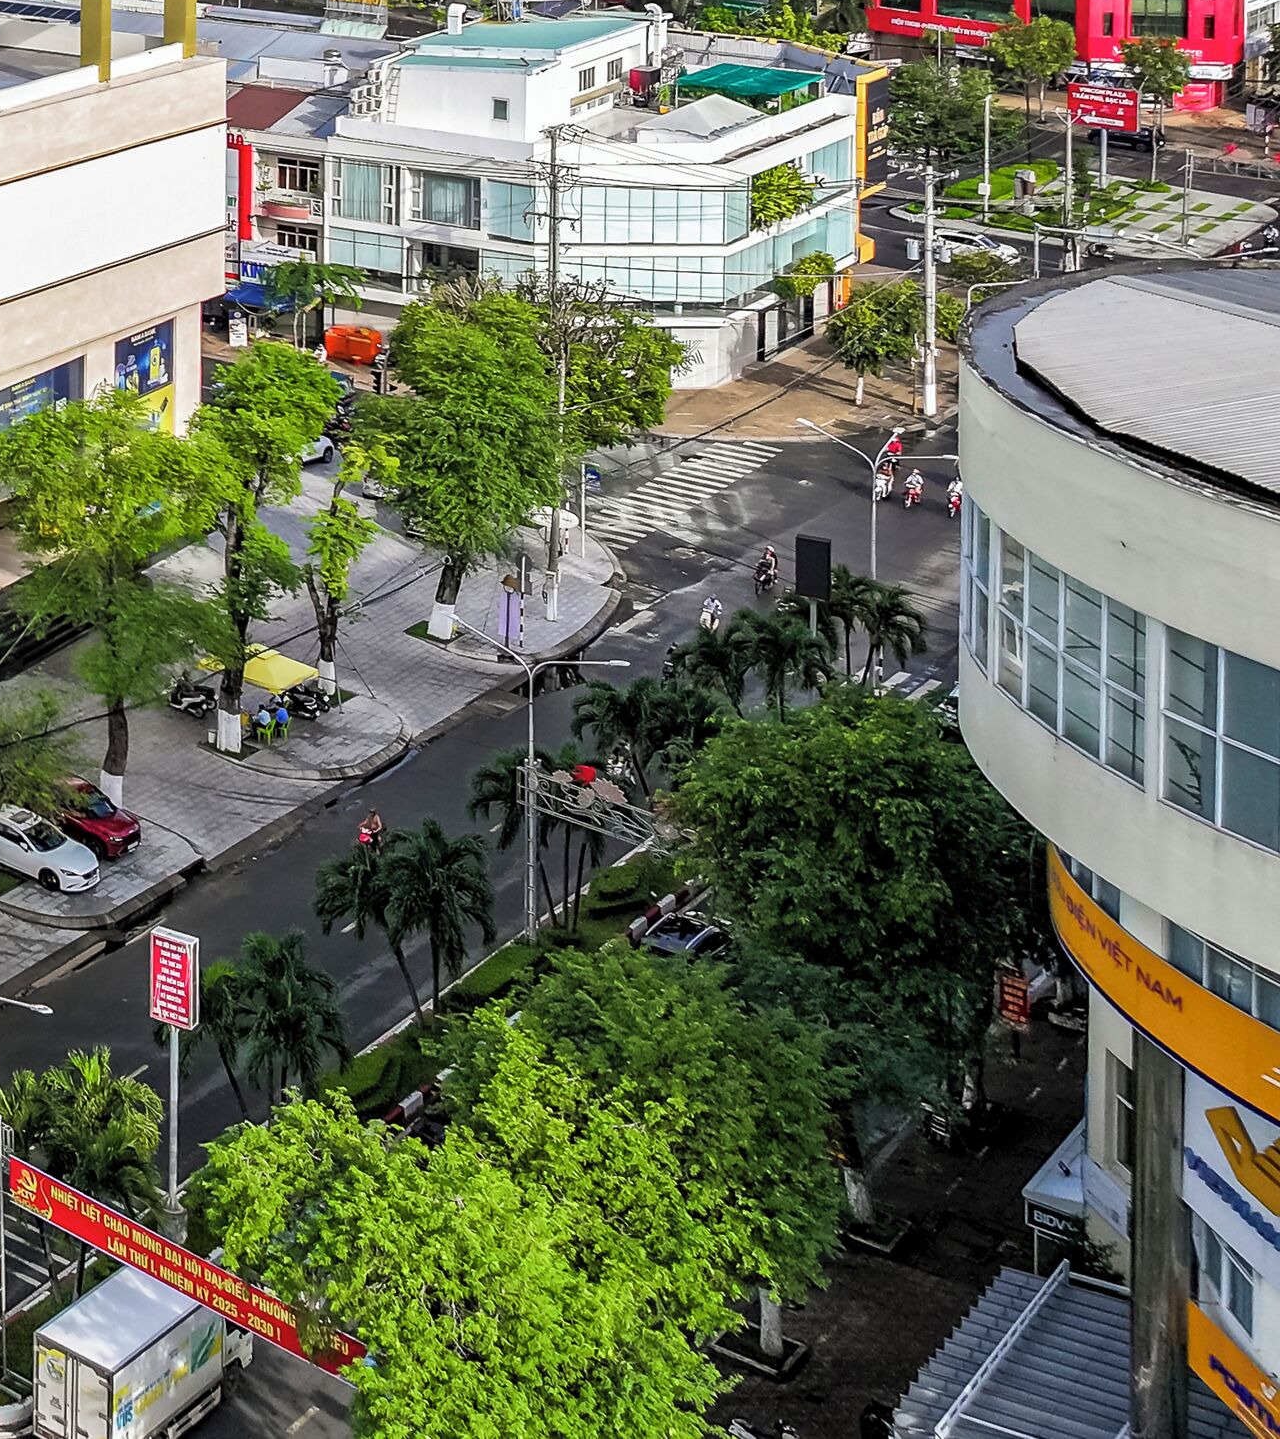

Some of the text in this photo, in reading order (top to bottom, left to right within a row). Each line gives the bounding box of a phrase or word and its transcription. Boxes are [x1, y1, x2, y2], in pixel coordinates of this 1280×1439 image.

[1106, 90, 1127, 98] PLAZA
[1098, 930, 1133, 973] VIỆT
[1136, 965, 1183, 1013] NAM
[50, 1185, 79, 1211] NHIỆT
[81, 1199, 101, 1224] LIỆT
[103, 1212, 130, 1239] CHÀO
[132, 1228, 162, 1257] MỪNG
[164, 1246, 182, 1267] ĐẠI
[184, 1259, 202, 1279] HỘI
[107, 1236, 127, 1259] LẦN
[129, 1247, 149, 1268] THỨ
[159, 1264, 194, 1294] NHIỆM
[212, 1294, 238, 1319] 2025
[247, 1312, 274, 1337] 2030
